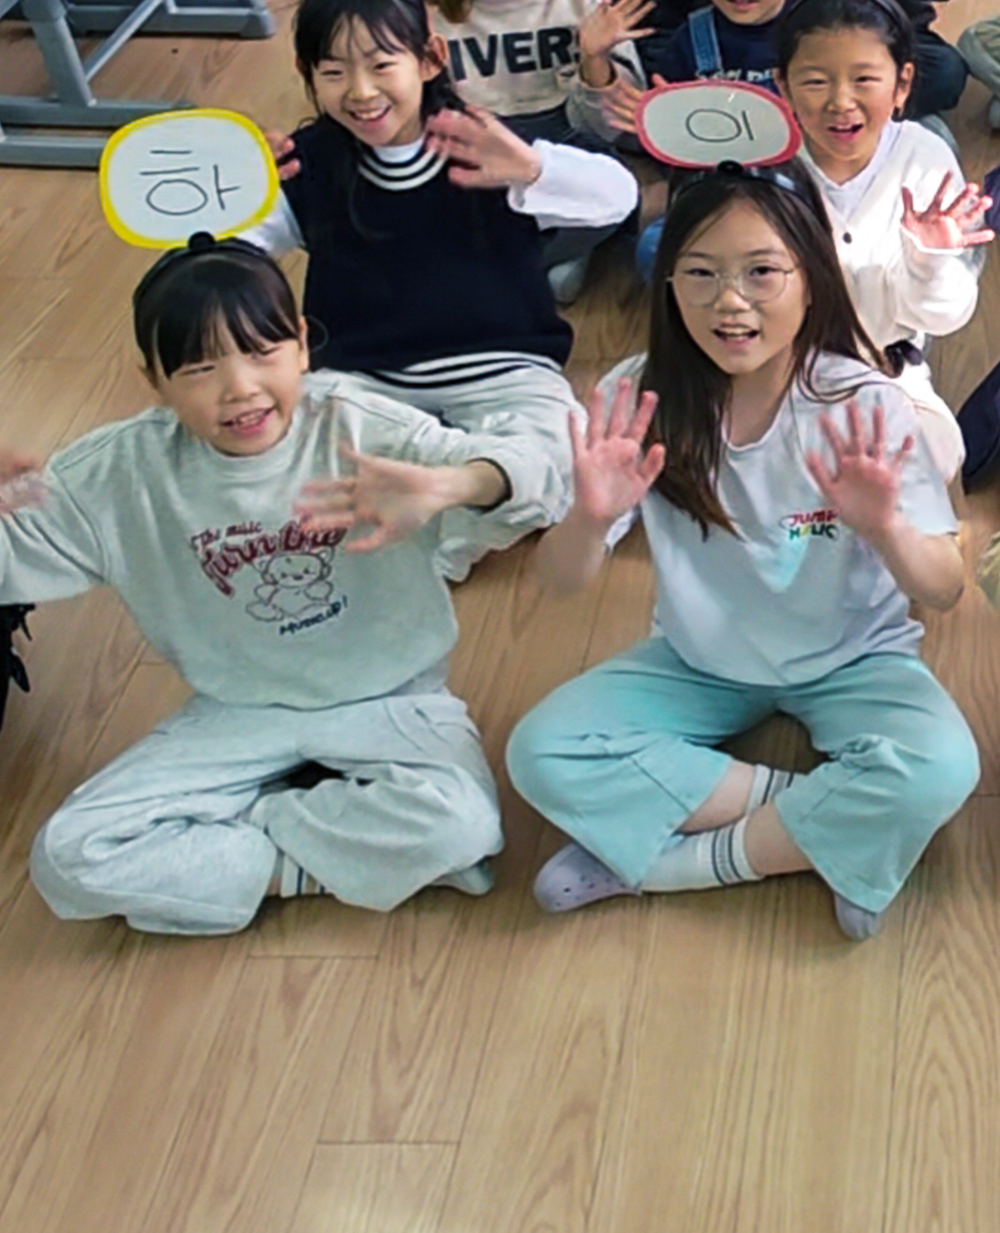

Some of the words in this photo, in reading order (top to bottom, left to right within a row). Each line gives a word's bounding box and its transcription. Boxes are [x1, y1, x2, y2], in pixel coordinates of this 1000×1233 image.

[447, 26, 579, 82] IVER
[685, 108, 755, 143] 이
[138, 149, 243, 218] 하
